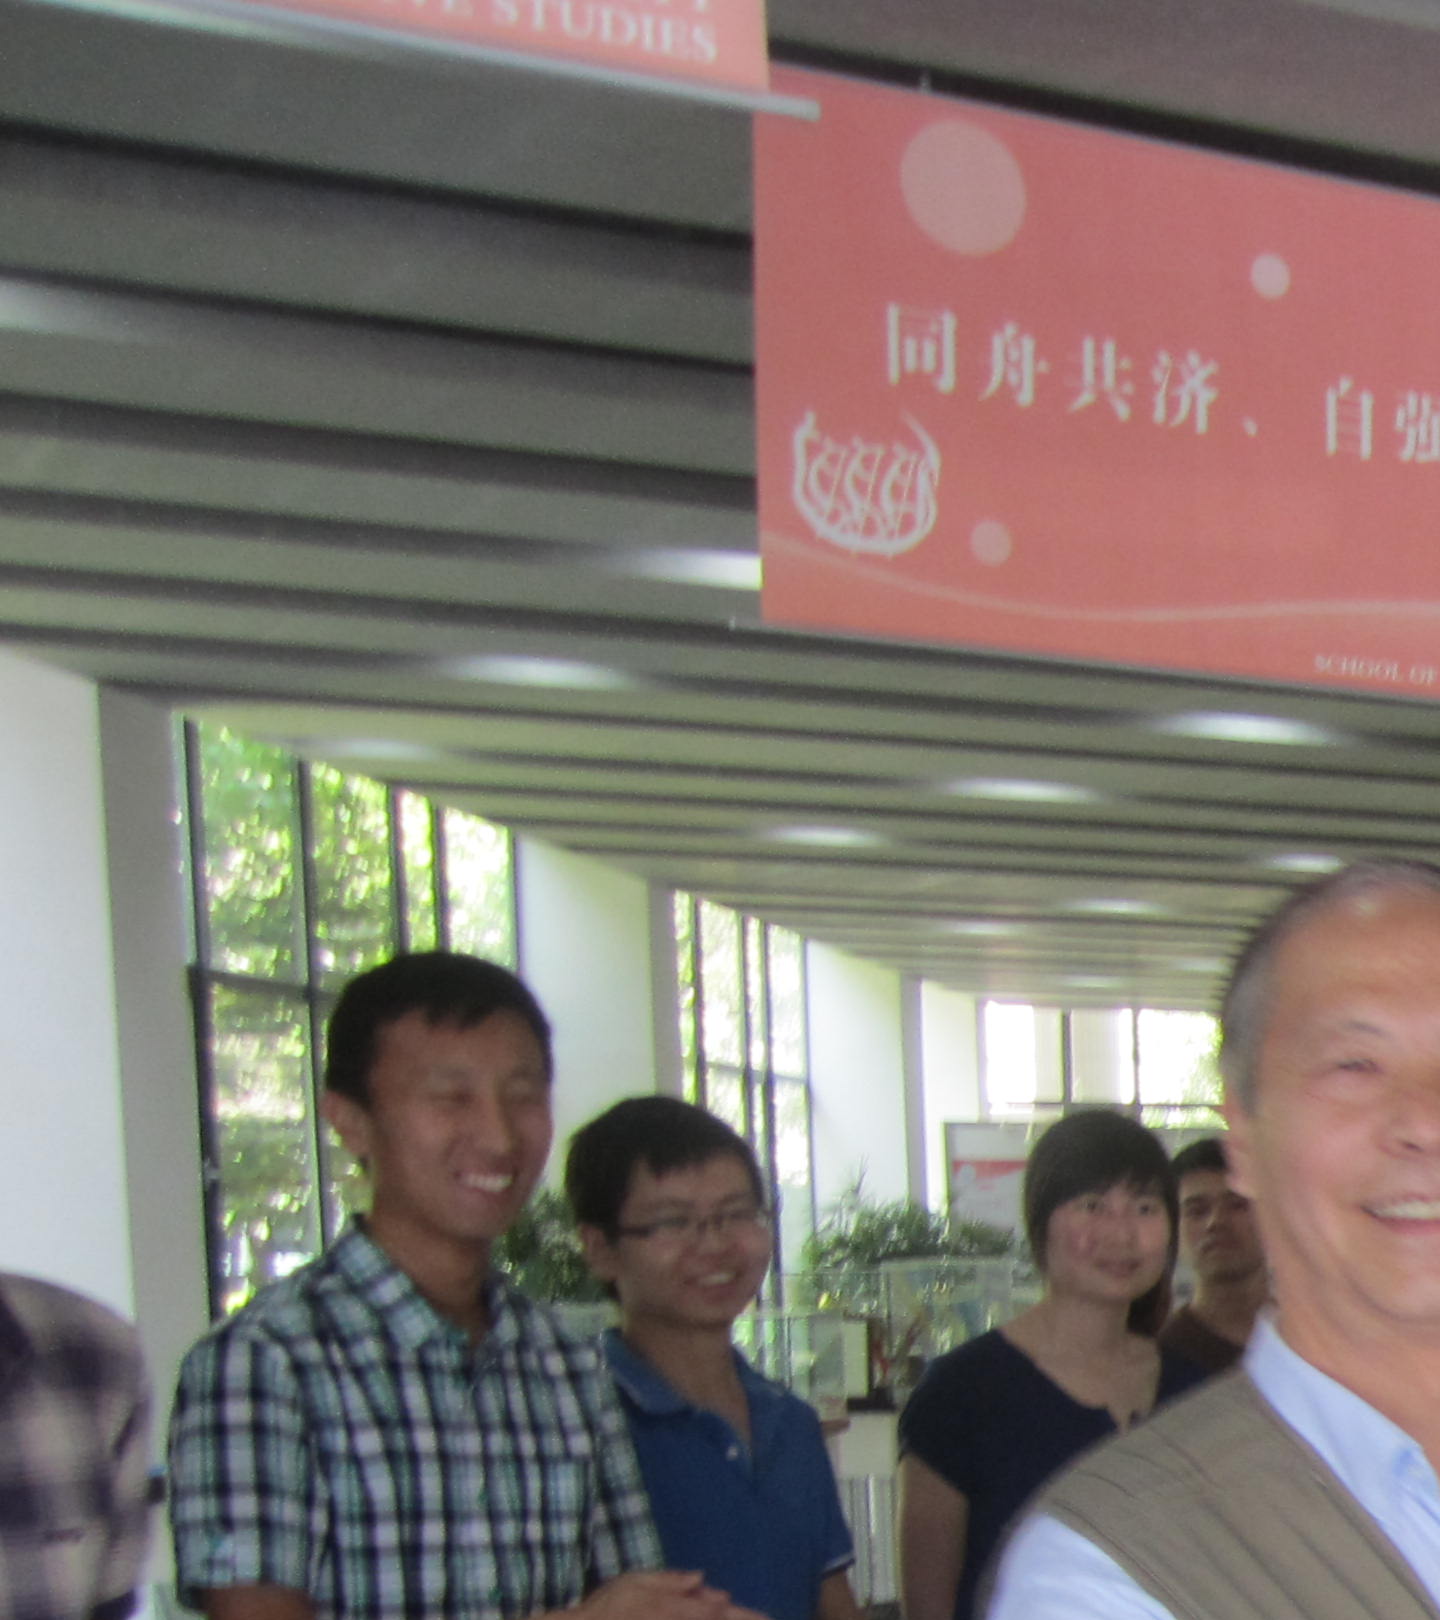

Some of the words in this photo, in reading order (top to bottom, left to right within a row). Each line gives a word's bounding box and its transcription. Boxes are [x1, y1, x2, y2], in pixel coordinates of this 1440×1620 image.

[491, 0, 718, 64] STUDIES
[1313, 653, 1402, 682] SCHOOL
[1407, 664, 1437, 687] OF
